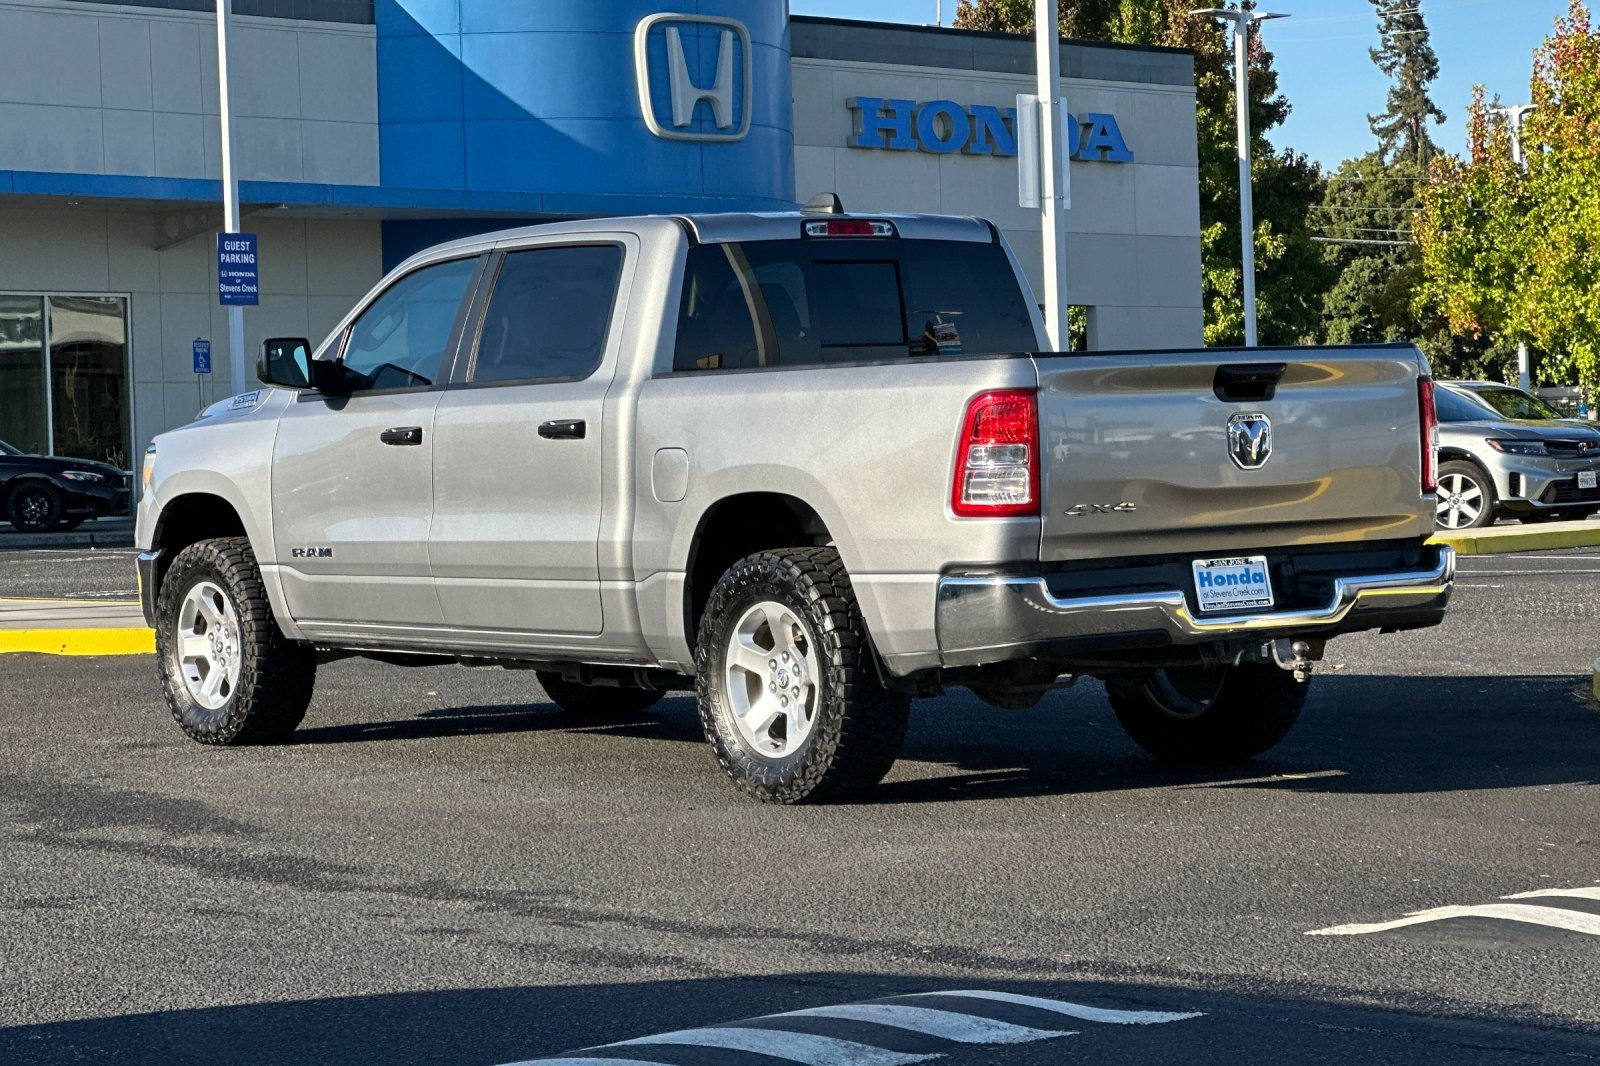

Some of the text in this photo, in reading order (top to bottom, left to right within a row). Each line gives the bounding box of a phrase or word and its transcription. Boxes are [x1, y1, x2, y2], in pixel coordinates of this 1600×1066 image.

[847, 96, 1135, 163] HONA
[224, 240, 251, 251] GUEST
[220, 253, 255, 264] PARKING
[220, 283, 258, 293] Stevens Creek
[292, 547, 333, 558] RAM
[1213, 558, 1247, 567] SAN JOSE
[1198, 567, 1265, 588] Honda
[1202, 591, 1209, 599] of
[1209, 588, 1233, 599] Stevens
